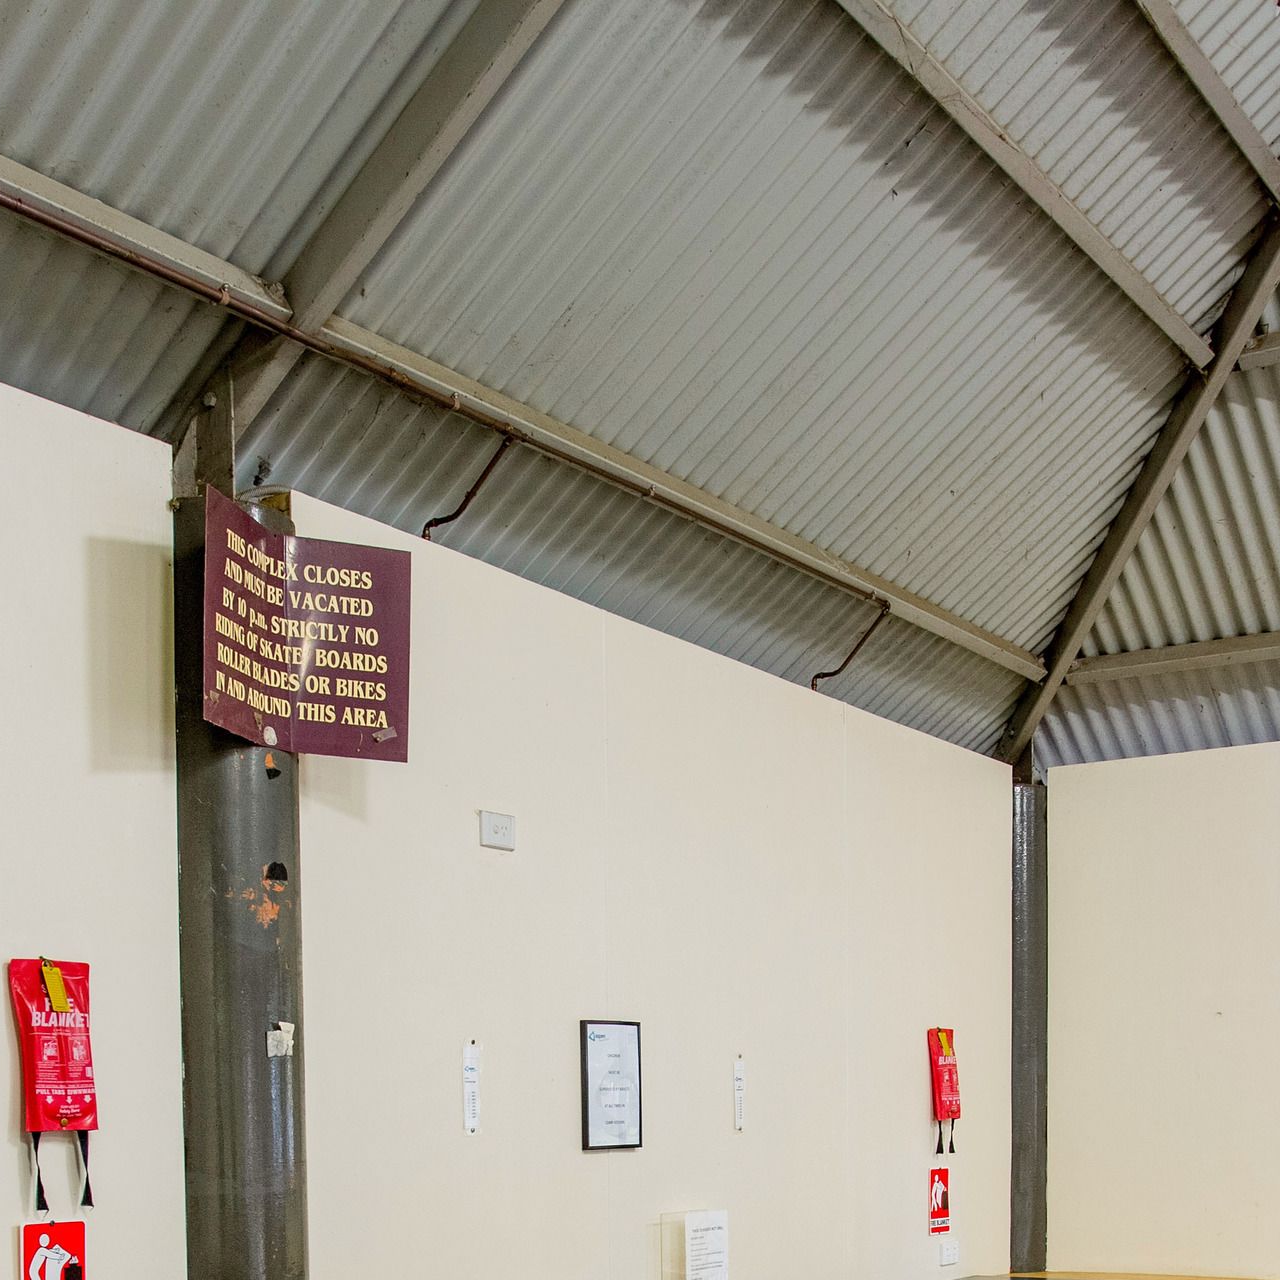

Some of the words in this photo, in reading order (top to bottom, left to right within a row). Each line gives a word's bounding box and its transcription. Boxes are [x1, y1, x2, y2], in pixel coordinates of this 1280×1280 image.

[224, 557, 242, 584] AND
[244, 569, 265, 600] MUST
[267, 584, 284, 606] BE
[289, 590, 374, 617] VACATED
[226, 528, 246, 558] THIS
[247, 543, 298, 581] COMPLEX
[303, 564, 372, 589] CLOSES
[215, 612, 245, 646] RIDING
[247, 631, 258, 652] OF
[260, 638, 302, 665] SKATE
[315, 648, 388, 674] BOARDS
[223, 586, 235, 611] BY
[238, 596, 247, 618] 10
[271, 615, 350, 643] STRICTLY
[355, 626, 379, 647] NO
[216, 670, 225, 692] IN
[227, 677, 246, 702] AND
[247, 687, 291, 718] AROUND
[296, 702, 336, 723] THIS
[340, 706, 388, 728] AREA
[217, 642, 251, 677] ROLLER
[252, 660, 300, 692] BLADES
[305, 675, 331, 695] OR
[335, 678, 387, 701] BIKES
